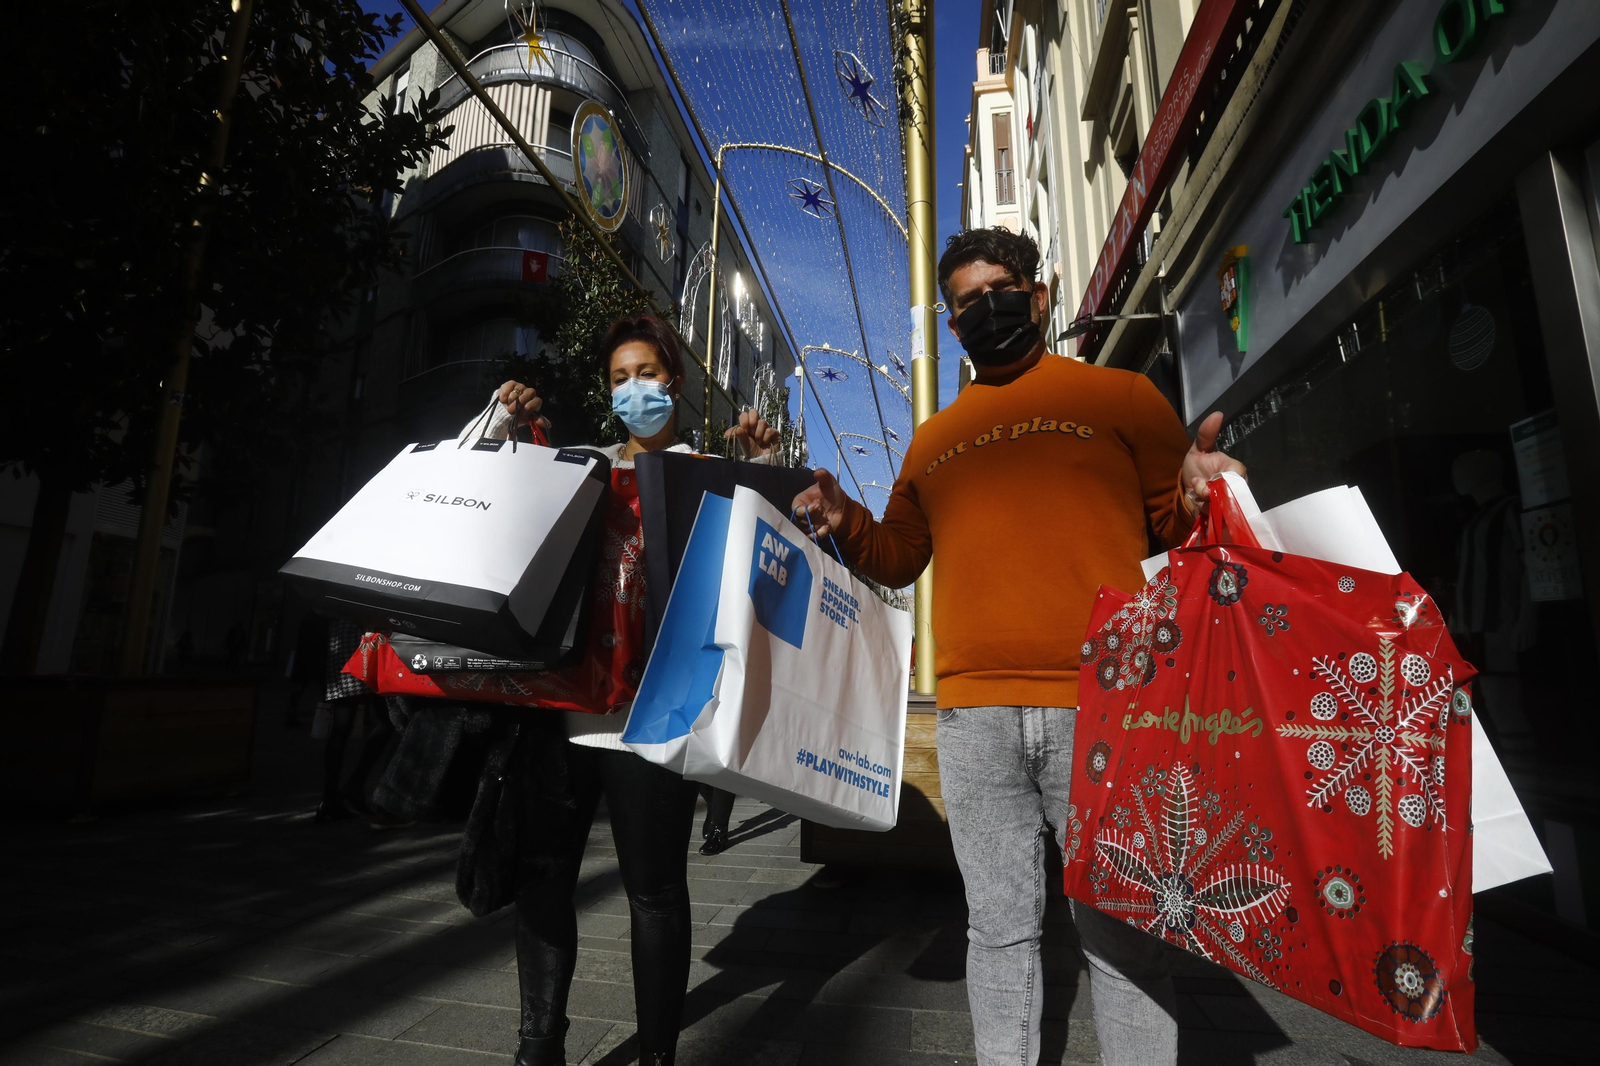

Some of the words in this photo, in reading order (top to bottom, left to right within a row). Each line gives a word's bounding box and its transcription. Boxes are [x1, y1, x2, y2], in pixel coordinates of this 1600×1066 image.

[1149, 66, 1191, 161] ASESORES
[1150, 39, 1212, 178] INMOBILIARIOS
[1282, 60, 1430, 245] TIENDA
[1433, 0, 1505, 64] O
[926, 440, 968, 476] out
[973, 424, 1005, 448] of
[1008, 416, 1095, 441] place
[423, 493, 492, 511] SILBON
[761, 532, 790, 563] AW
[354, 573, 422, 592] SILBONSHOP.COM
[758, 550, 789, 587] LAB
[821, 589, 860, 624] APPAREL.
[823, 576, 862, 613] SNEAKER.
[819, 601, 849, 630] STORE.
[796, 748, 890, 798] #PLAYWITHSTYLE
[838, 748, 892, 779] aw-lab.com
